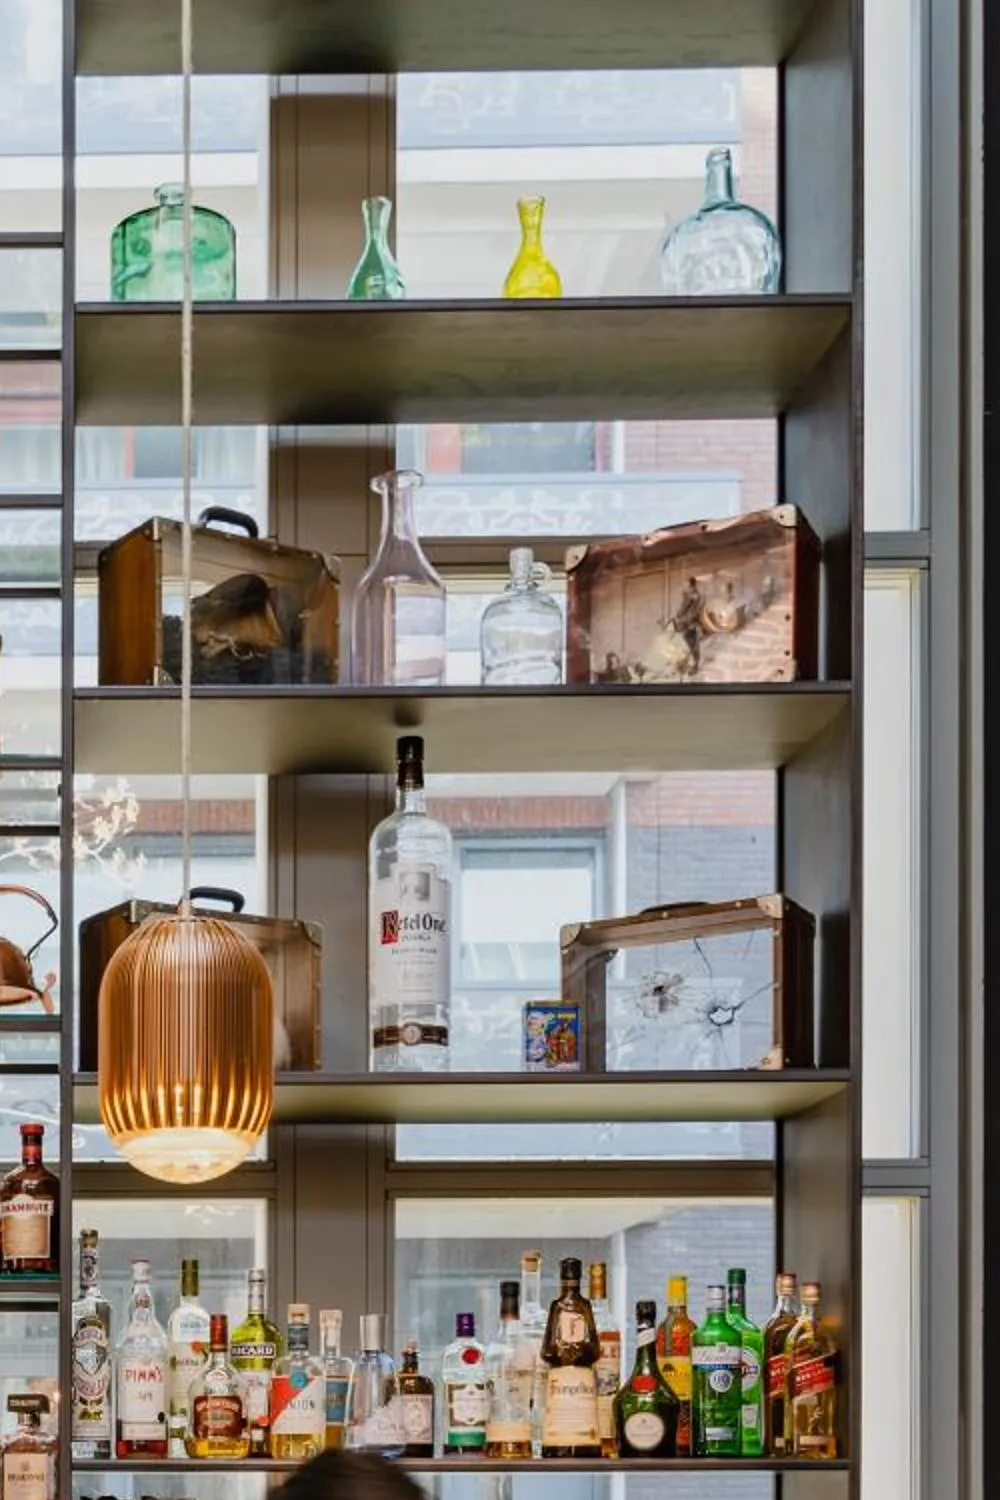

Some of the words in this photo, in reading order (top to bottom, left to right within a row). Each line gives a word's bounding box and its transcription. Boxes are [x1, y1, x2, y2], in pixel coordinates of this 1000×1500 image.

[381, 910, 420, 943] Ketel
[422, 912, 447, 933] One
[231, 1344, 273, 1355] RICARD
[124, 1367, 164, 1383] PIMM'S
